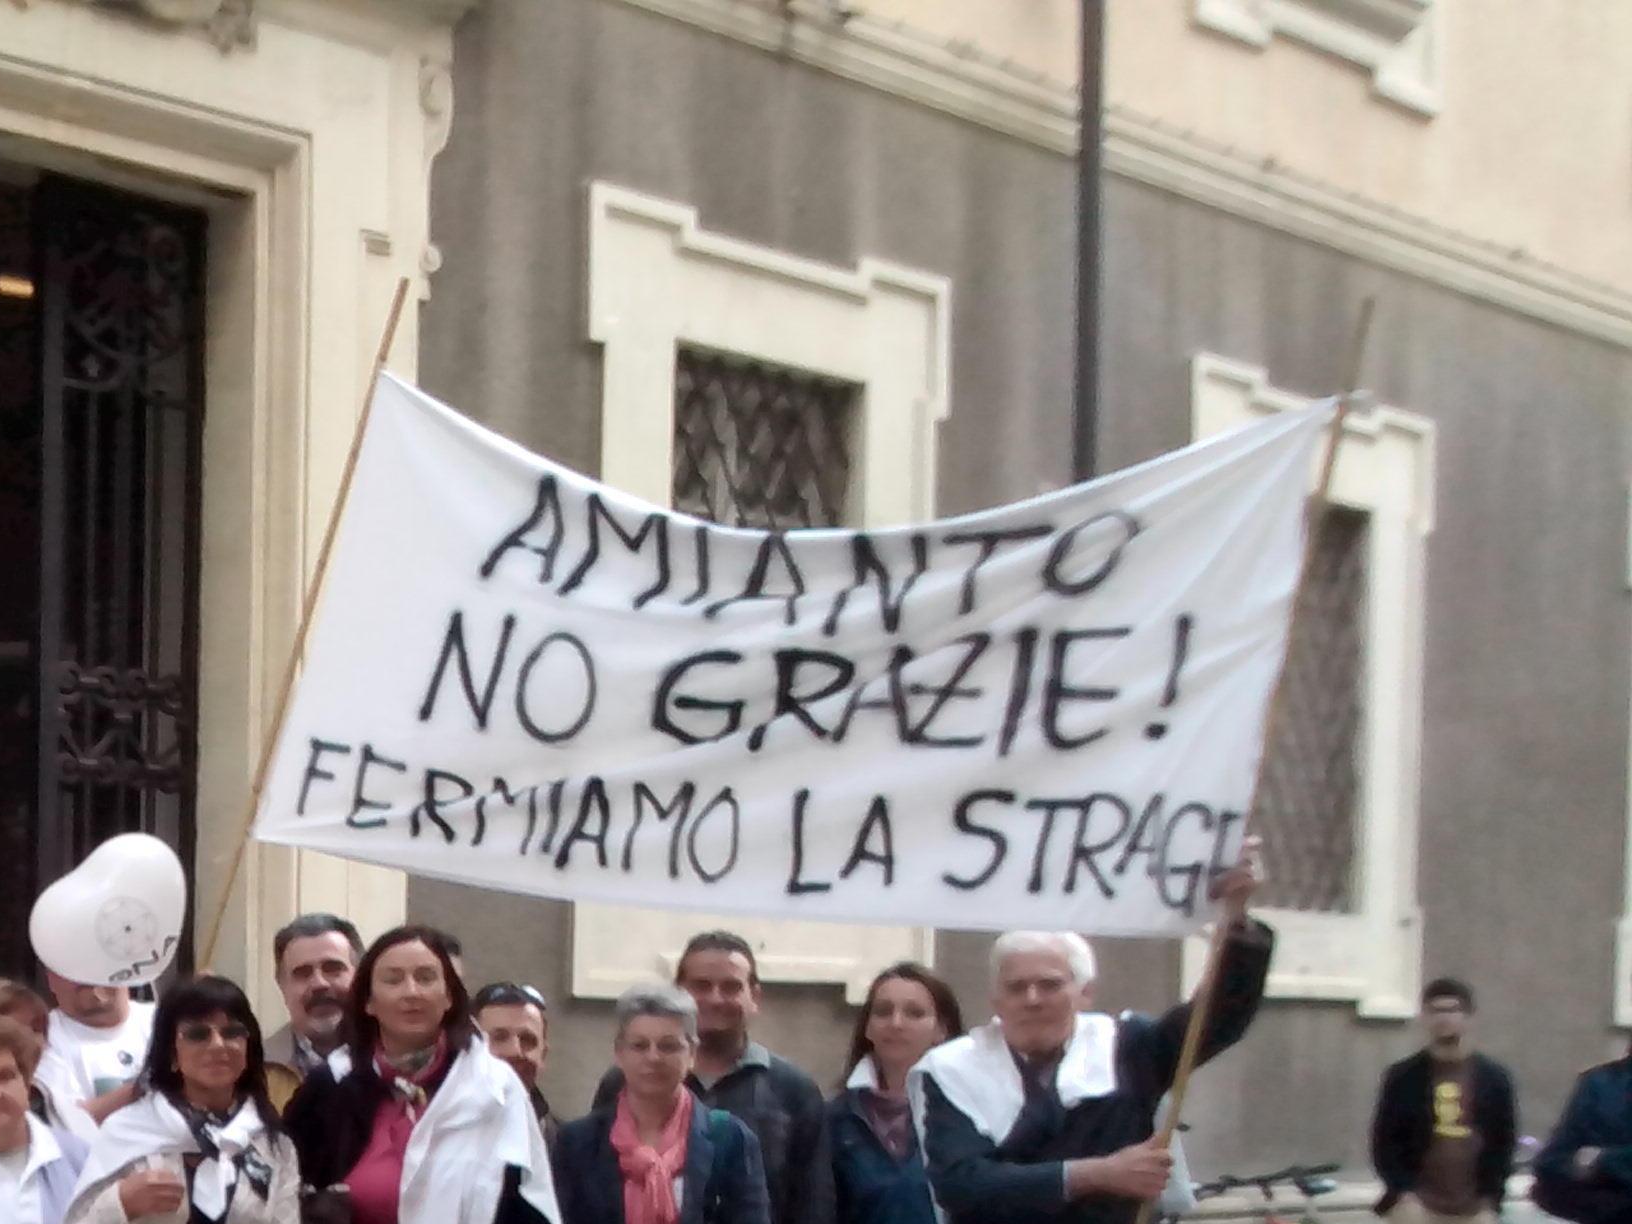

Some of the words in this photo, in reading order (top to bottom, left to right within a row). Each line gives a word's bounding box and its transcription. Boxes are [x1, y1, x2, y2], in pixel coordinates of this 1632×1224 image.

[479, 474, 1141, 638] AMIANTO
[418, 609, 596, 744] NO
[297, 737, 741, 883] FERMIAMO
[786, 788, 894, 895] LA
